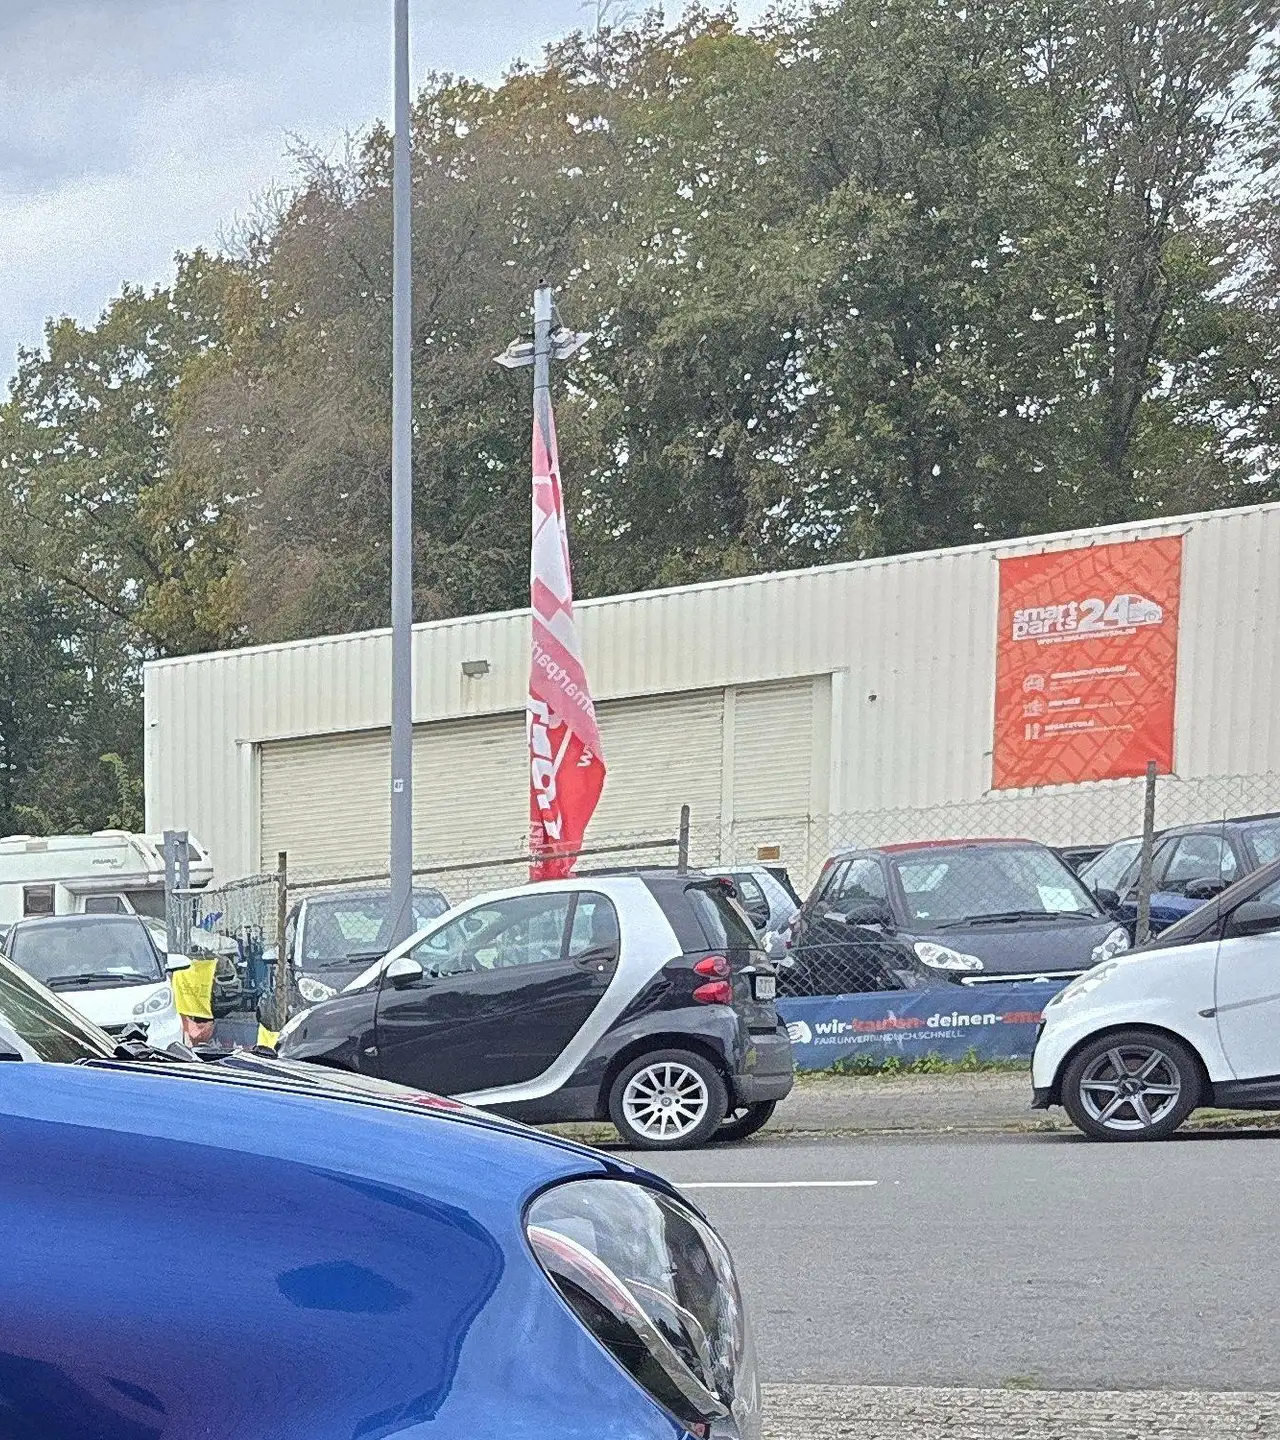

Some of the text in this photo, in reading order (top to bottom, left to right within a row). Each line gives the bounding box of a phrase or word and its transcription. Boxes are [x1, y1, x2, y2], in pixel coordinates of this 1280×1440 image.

[1013, 601, 1078, 622] smart
[1078, 594, 1129, 631] 24
[1013, 615, 1077, 640] parts
